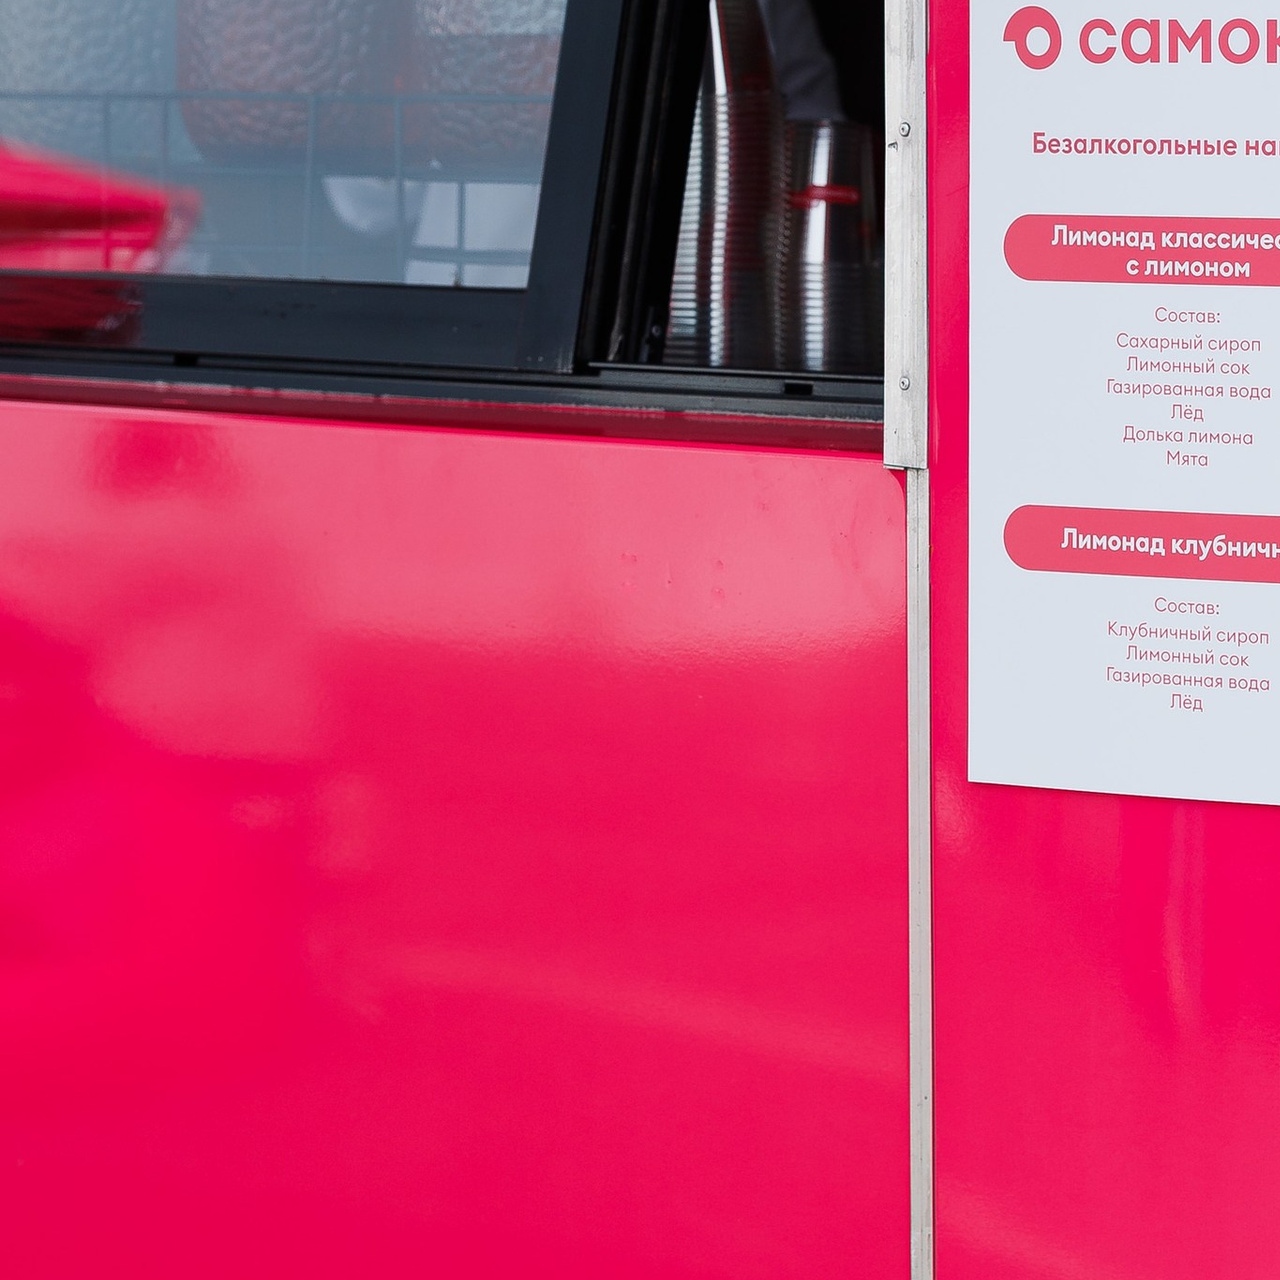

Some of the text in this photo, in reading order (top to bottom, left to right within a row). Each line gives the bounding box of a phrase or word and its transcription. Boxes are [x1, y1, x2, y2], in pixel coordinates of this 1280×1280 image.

[1032, 131, 1238, 156] Безалкогольные
[1051, 224, 1156, 251] Лимонад
[1126, 259, 1250, 278] с лимоном
[1154, 306, 1221, 324] Состав:
[1116, 332, 1261, 355] Сахарный сироп
[1126, 355, 1251, 375] Лимонный сок
[1107, 378, 1271, 401] Газированная вода
[1170, 403, 1205, 423] Лёд
[1122, 425, 1253, 446] Долька лимона
[1166, 449, 1208, 467] Мята
[1061, 527, 1166, 557] Лимонад
[1154, 596, 1220, 615] Состав:
[1108, 620, 1269, 648] Клубничный сироп
[1125, 644, 1250, 667] Лимонный сок
[1106, 666, 1270, 693] Газированная вода
[1170, 693, 1204, 713] Лёд
